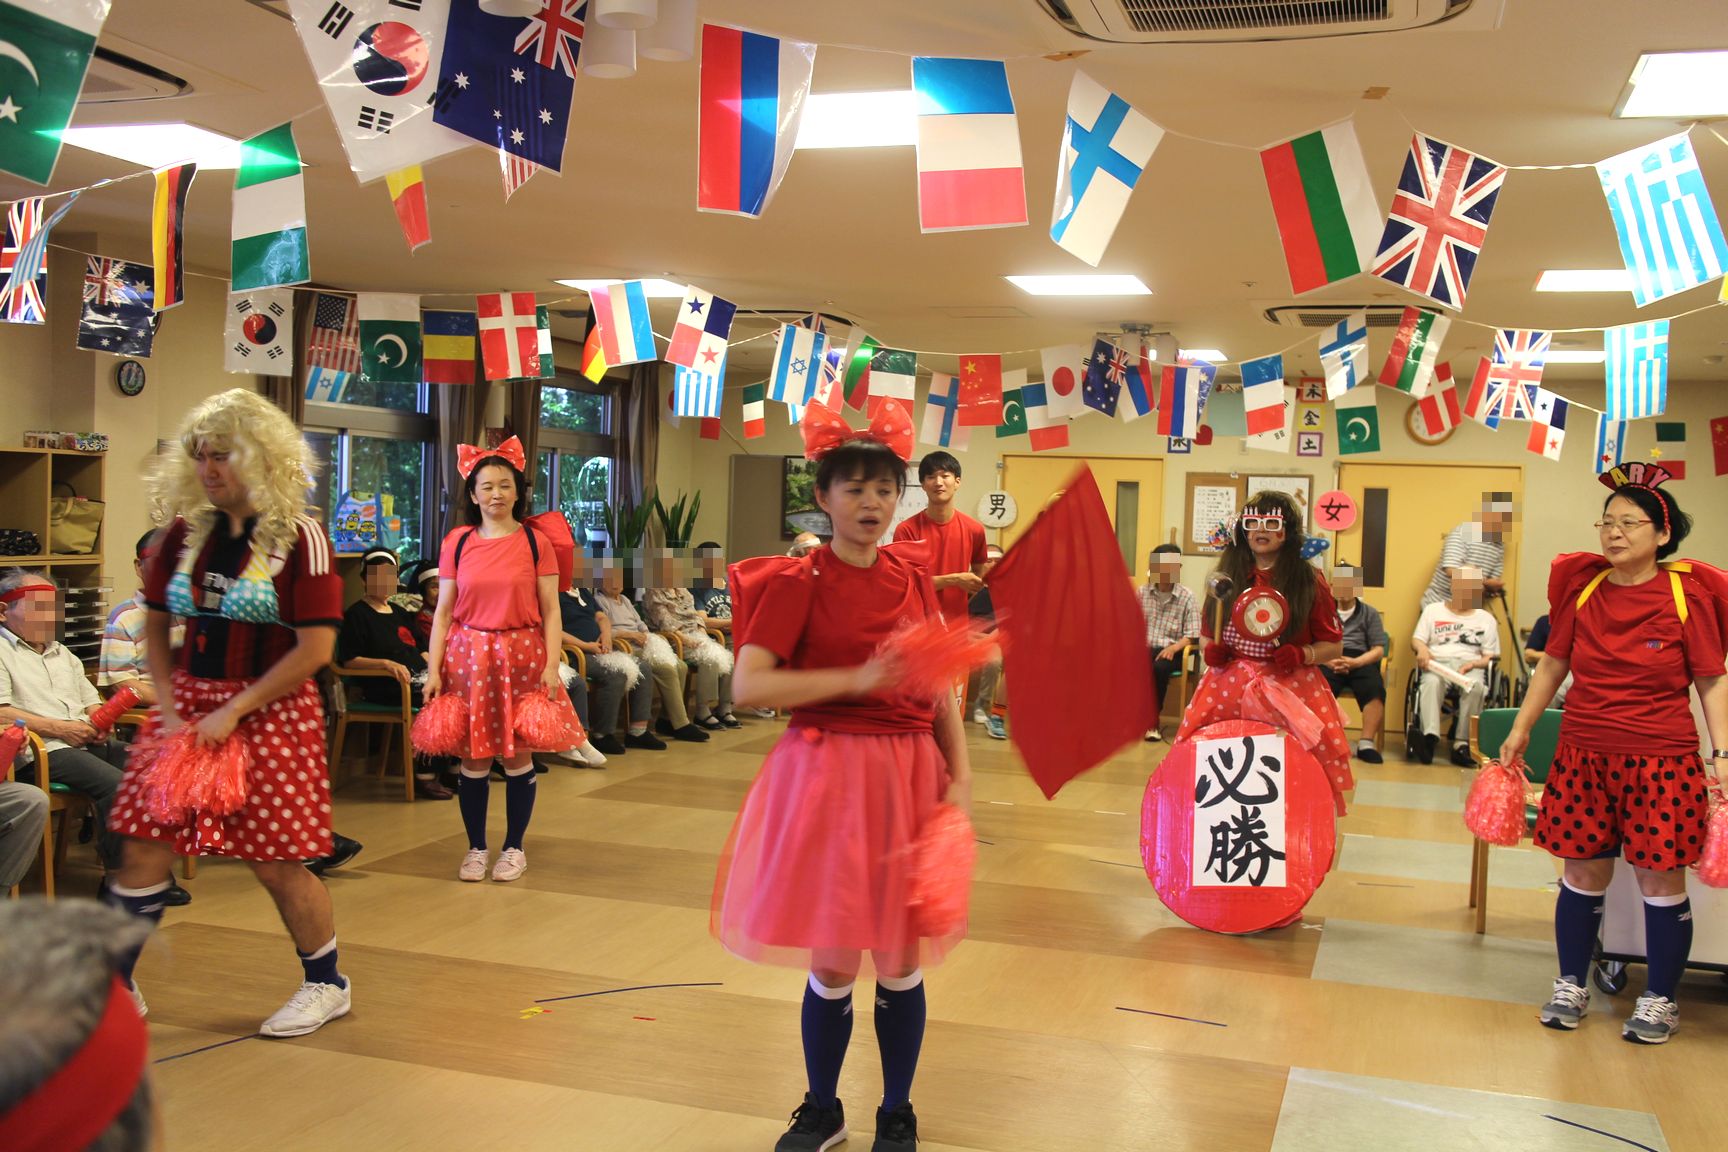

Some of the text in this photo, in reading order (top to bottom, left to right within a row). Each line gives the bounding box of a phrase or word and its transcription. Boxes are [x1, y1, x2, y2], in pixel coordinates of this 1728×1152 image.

[1304, 410, 1320, 426] 金
[1302, 438, 1317, 450] 土
[989, 494, 1006, 520] 男
[1320, 497, 1350, 521] 女
[1195, 736, 1286, 887] 必勝
